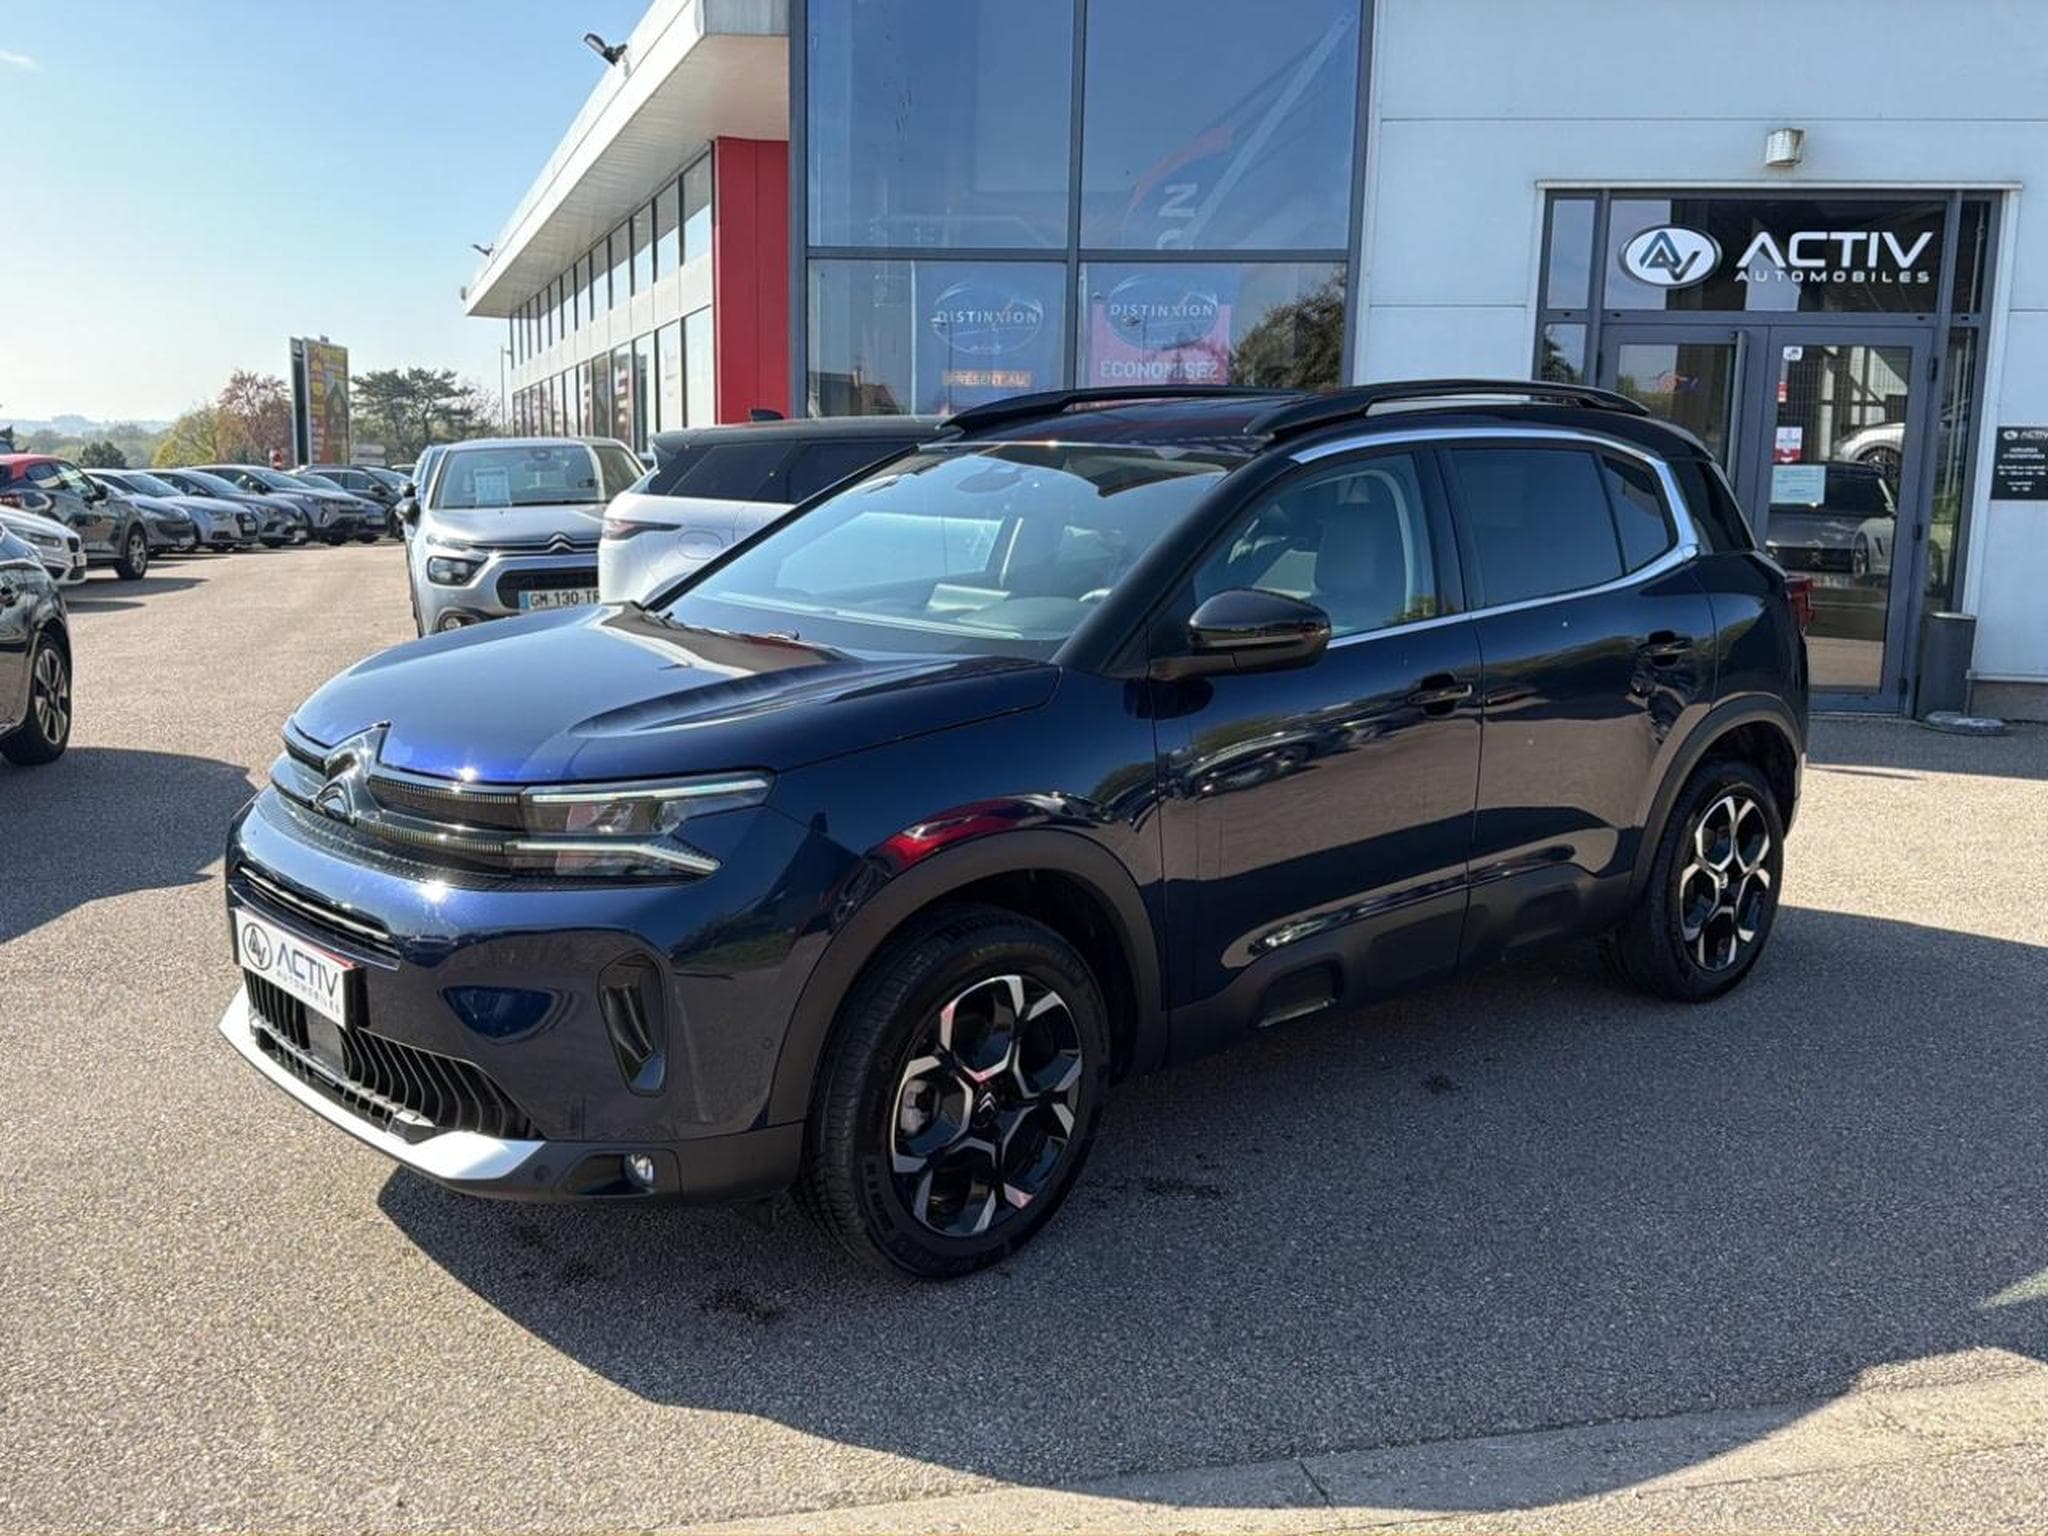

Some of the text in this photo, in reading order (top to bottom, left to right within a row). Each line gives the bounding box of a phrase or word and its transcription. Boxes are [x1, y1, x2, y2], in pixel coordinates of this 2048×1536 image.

[1735, 231, 1934, 269] ACTIV
[1733, 270, 1930, 284] AUTOMOBILES
[936, 310, 1038, 323] DISTINXION
[1110, 303, 1213, 317] DISTINXION
[277, 942, 338, 998] ACTIV
